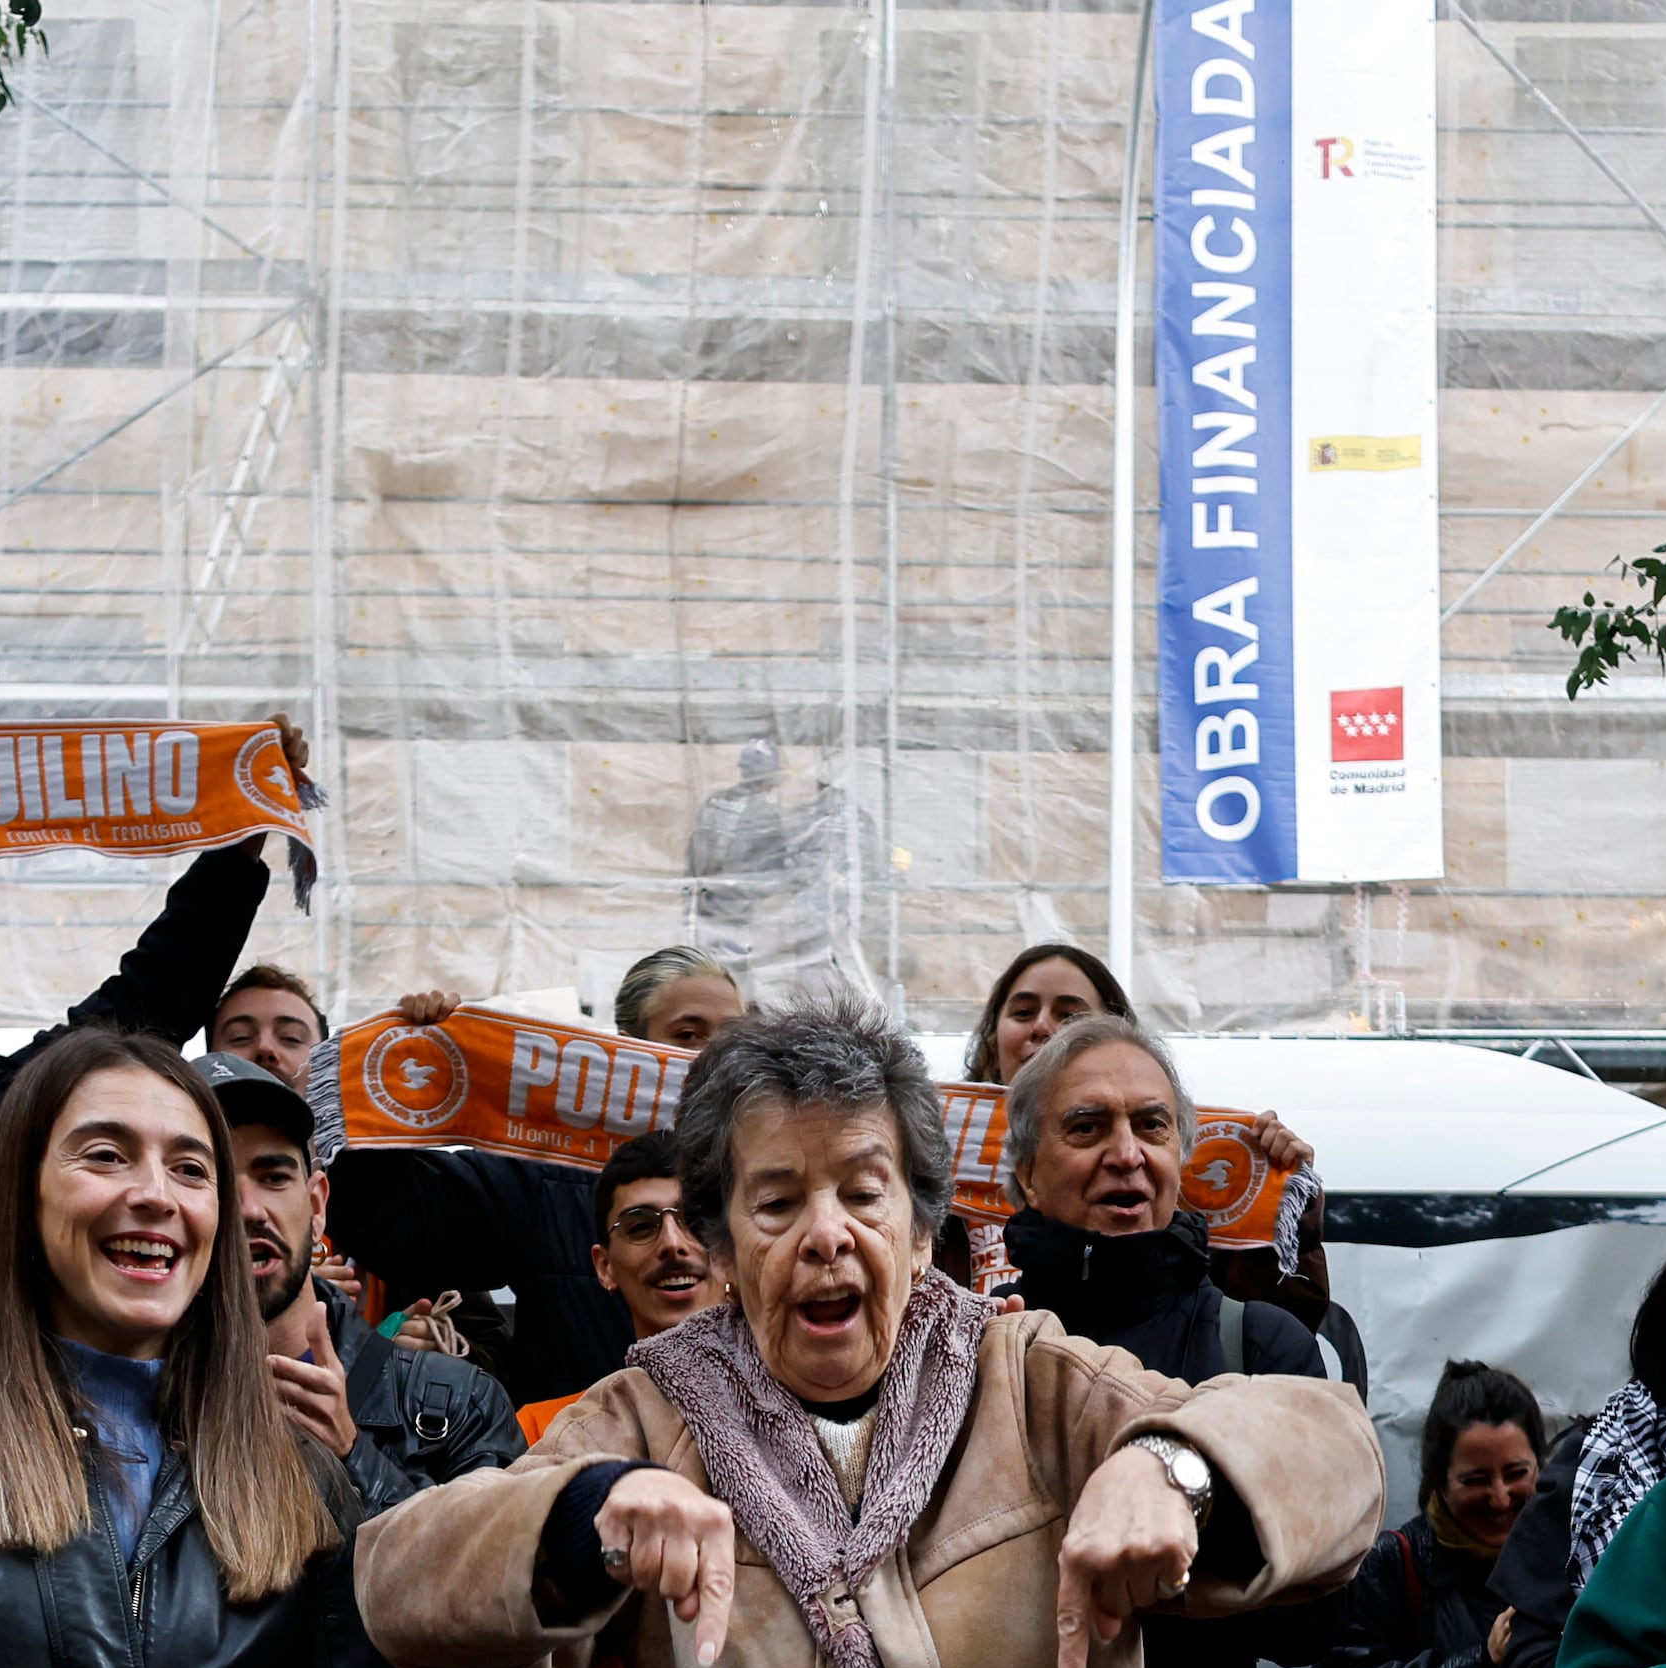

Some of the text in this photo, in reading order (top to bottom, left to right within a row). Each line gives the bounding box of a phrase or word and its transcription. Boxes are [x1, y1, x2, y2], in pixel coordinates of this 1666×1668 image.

[1190, 0, 1262, 842] OBRA FINANCIADA
[1329, 767, 1407, 780] Comunidad
[1330, 781, 1407, 795] de Madrid
[82, 826, 101, 842] el
